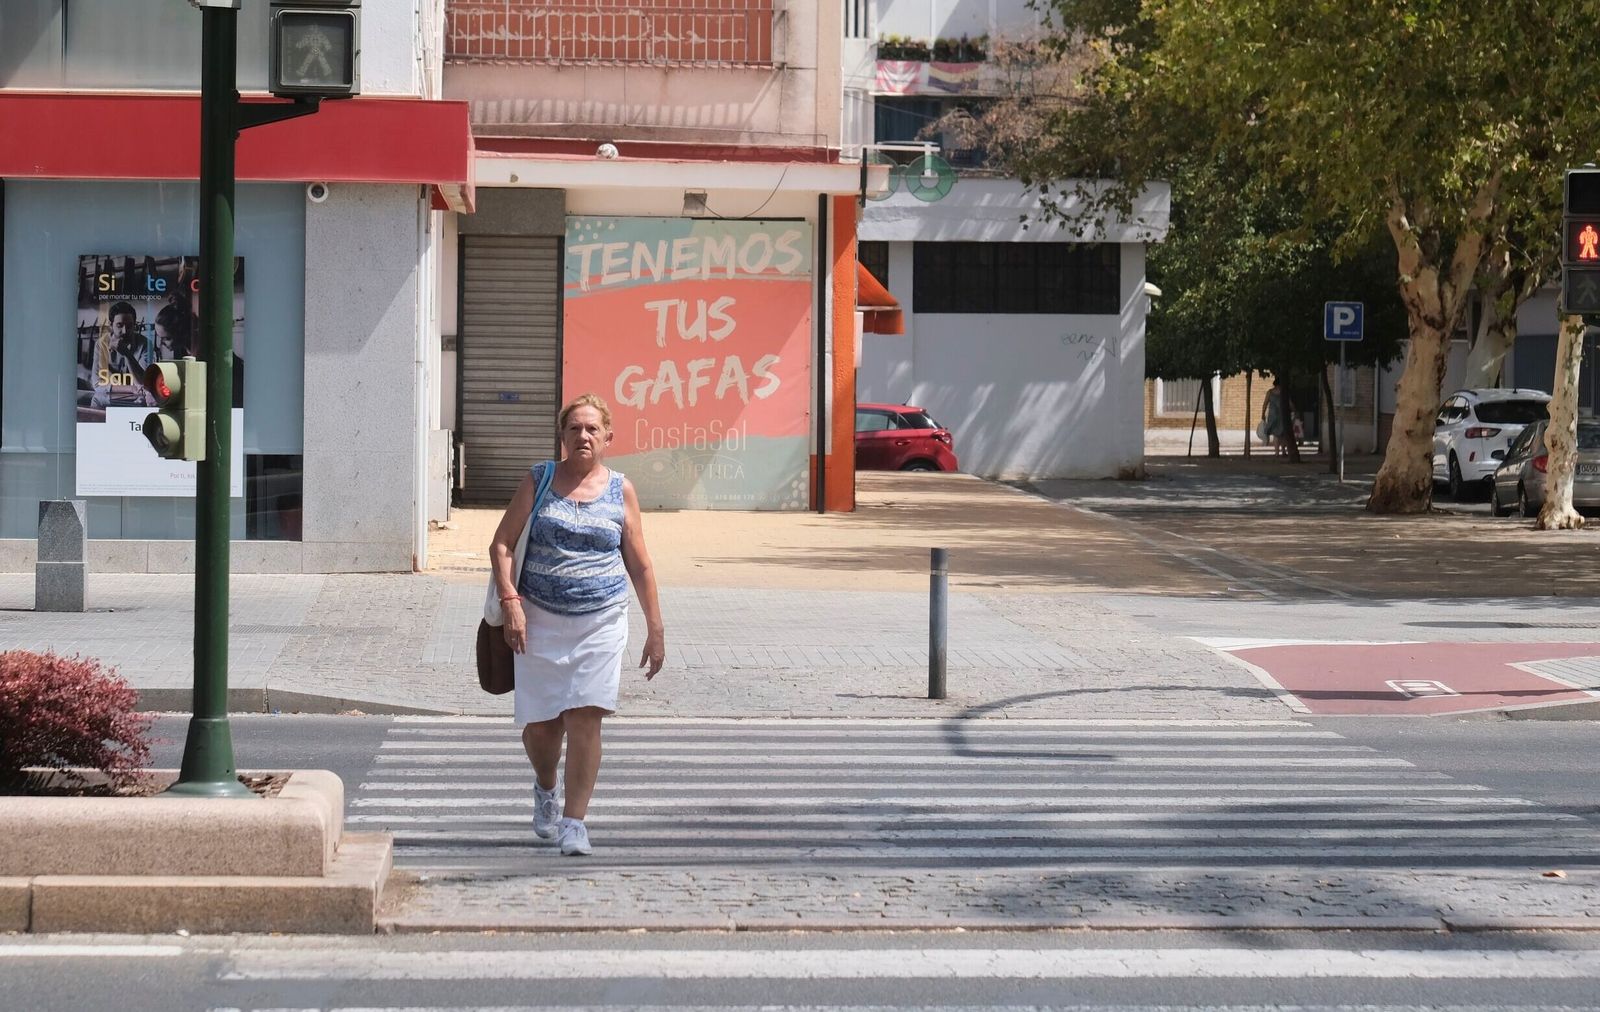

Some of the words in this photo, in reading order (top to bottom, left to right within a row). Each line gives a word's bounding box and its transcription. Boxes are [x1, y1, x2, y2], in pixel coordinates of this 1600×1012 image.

[568, 230, 803, 292] TENEMOS
[98, 273, 115, 291] Si
[147, 274, 166, 291] te
[645, 296, 736, 348] TUS
[1333, 306, 1355, 335] P
[98, 368, 134, 386] San
[614, 354, 781, 410] GAFAS
[635, 418, 747, 452] CostaSol
